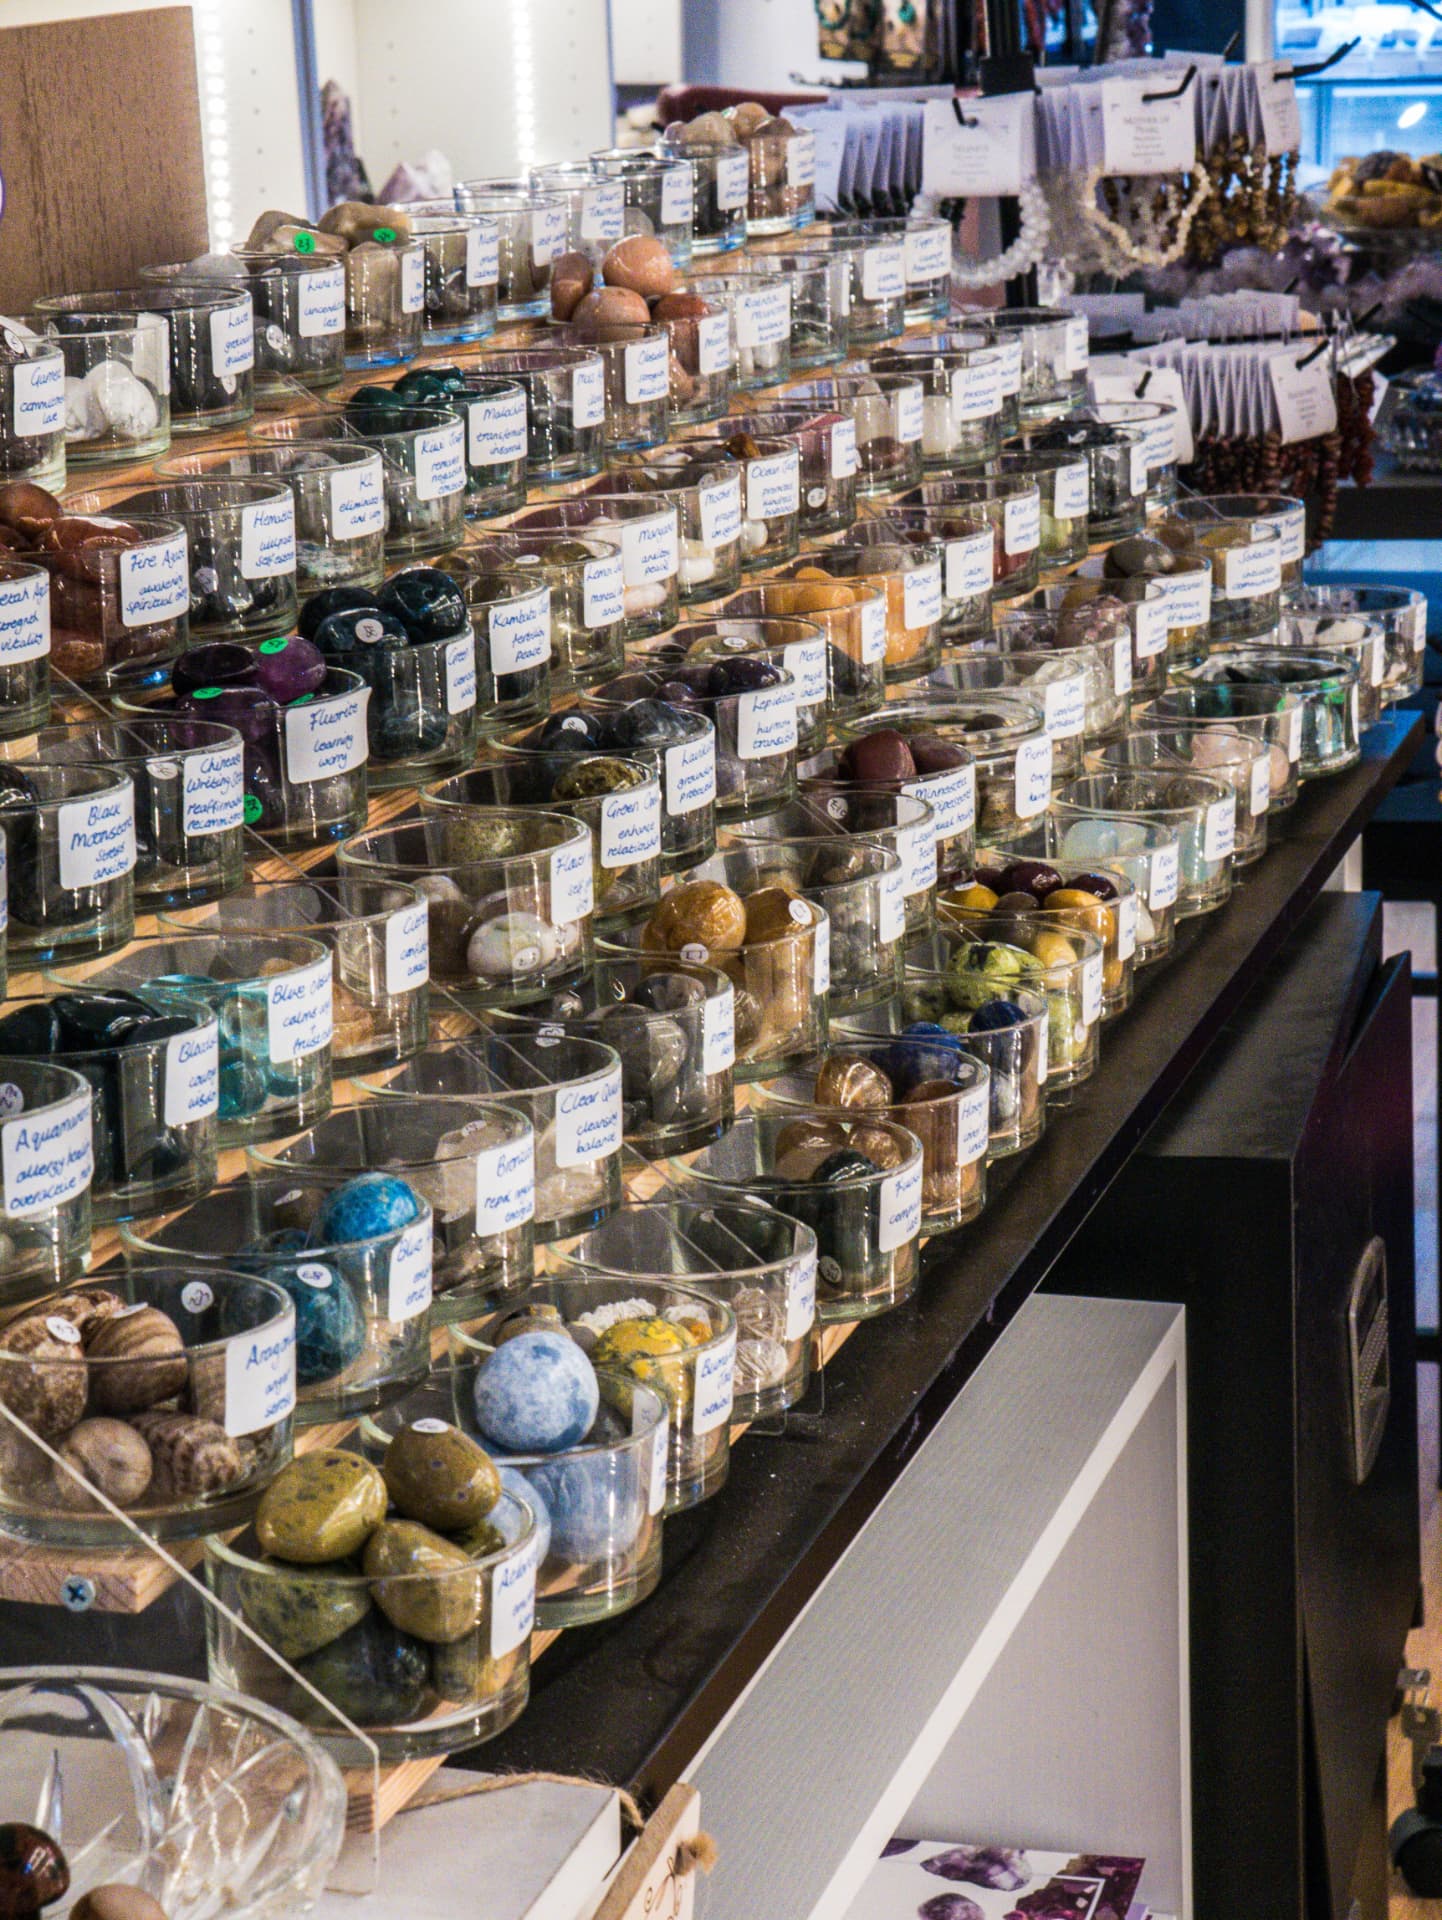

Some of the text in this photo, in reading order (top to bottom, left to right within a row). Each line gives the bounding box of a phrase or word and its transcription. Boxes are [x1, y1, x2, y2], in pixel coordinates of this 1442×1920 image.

[606, 799, 640, 820] Green
[272, 983, 305, 1005] Blue
[560, 1085, 599, 1115] Clear
